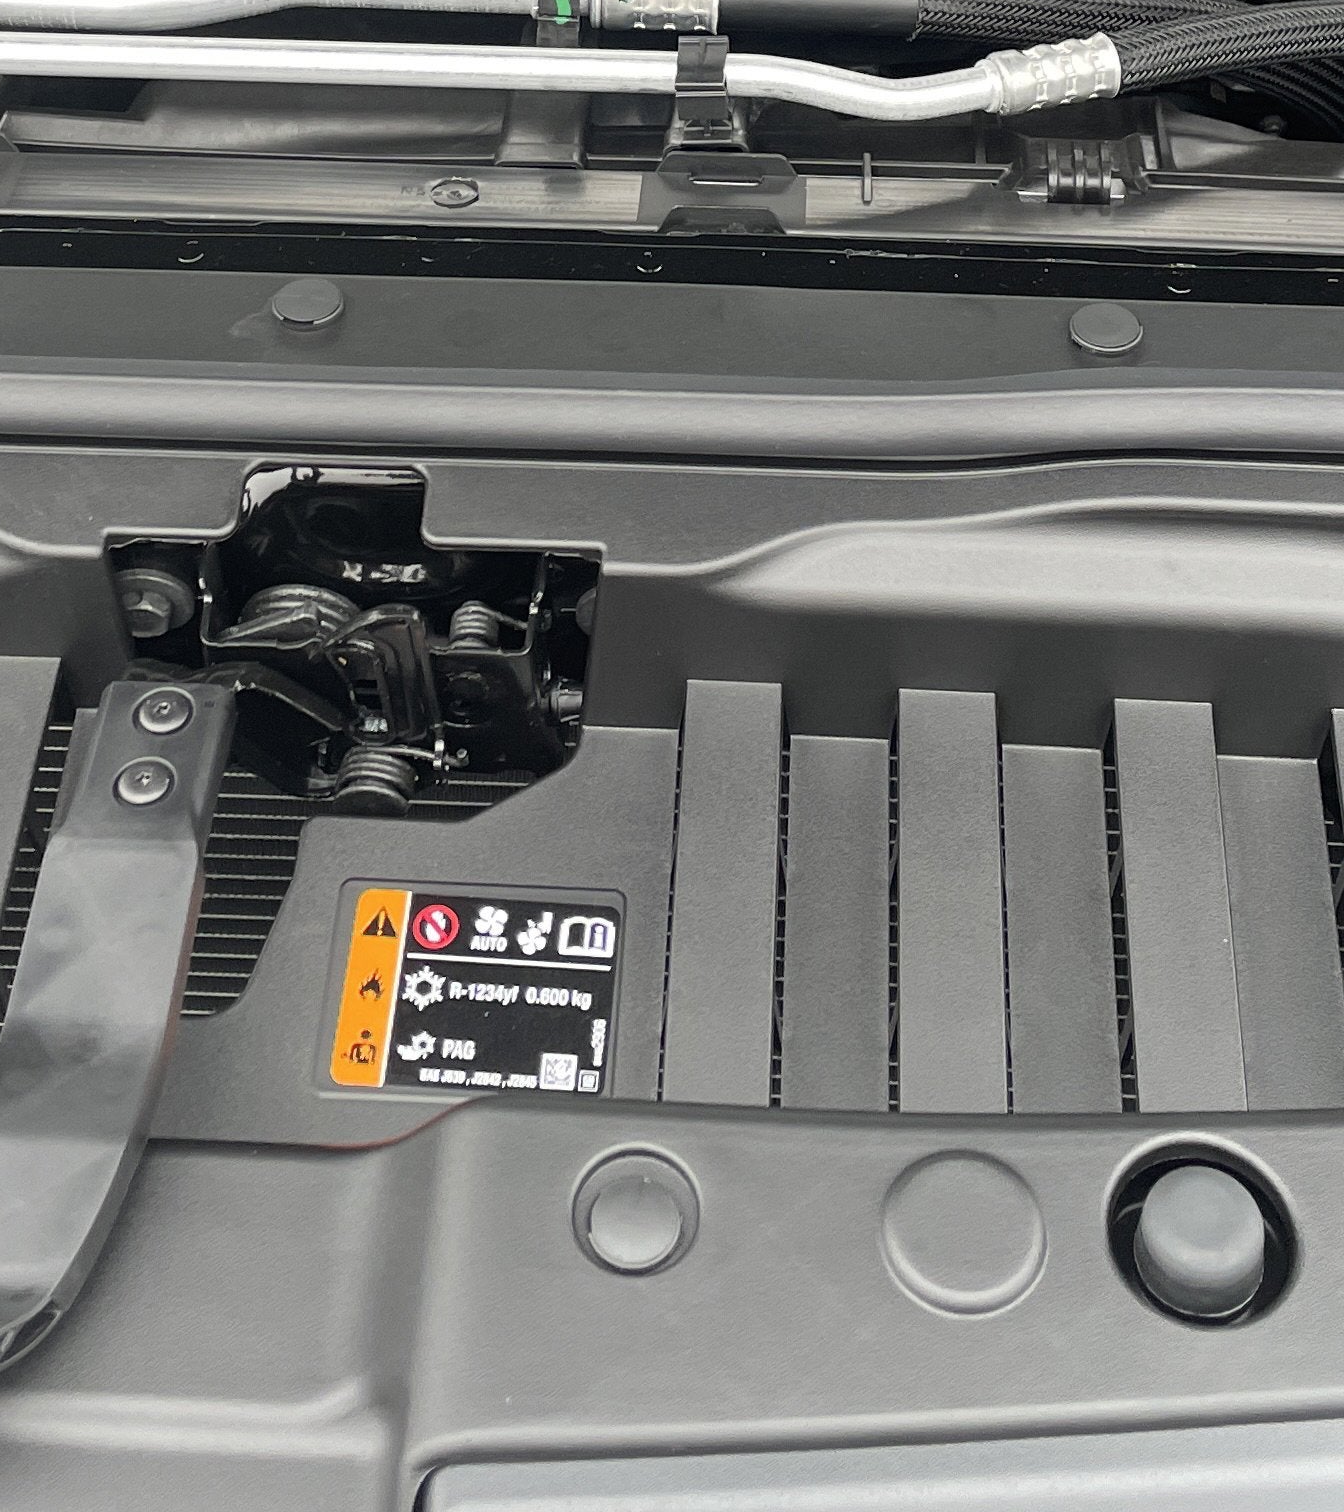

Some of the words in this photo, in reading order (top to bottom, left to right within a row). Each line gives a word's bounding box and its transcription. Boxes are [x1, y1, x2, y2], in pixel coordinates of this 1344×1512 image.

[469, 934, 508, 953] AUTO
[449, 981, 520, 1006] R-1234yf
[525, 986, 570, 1007] 0.600
[570, 989, 593, 1011] kg
[442, 1038, 477, 1061] PAG
